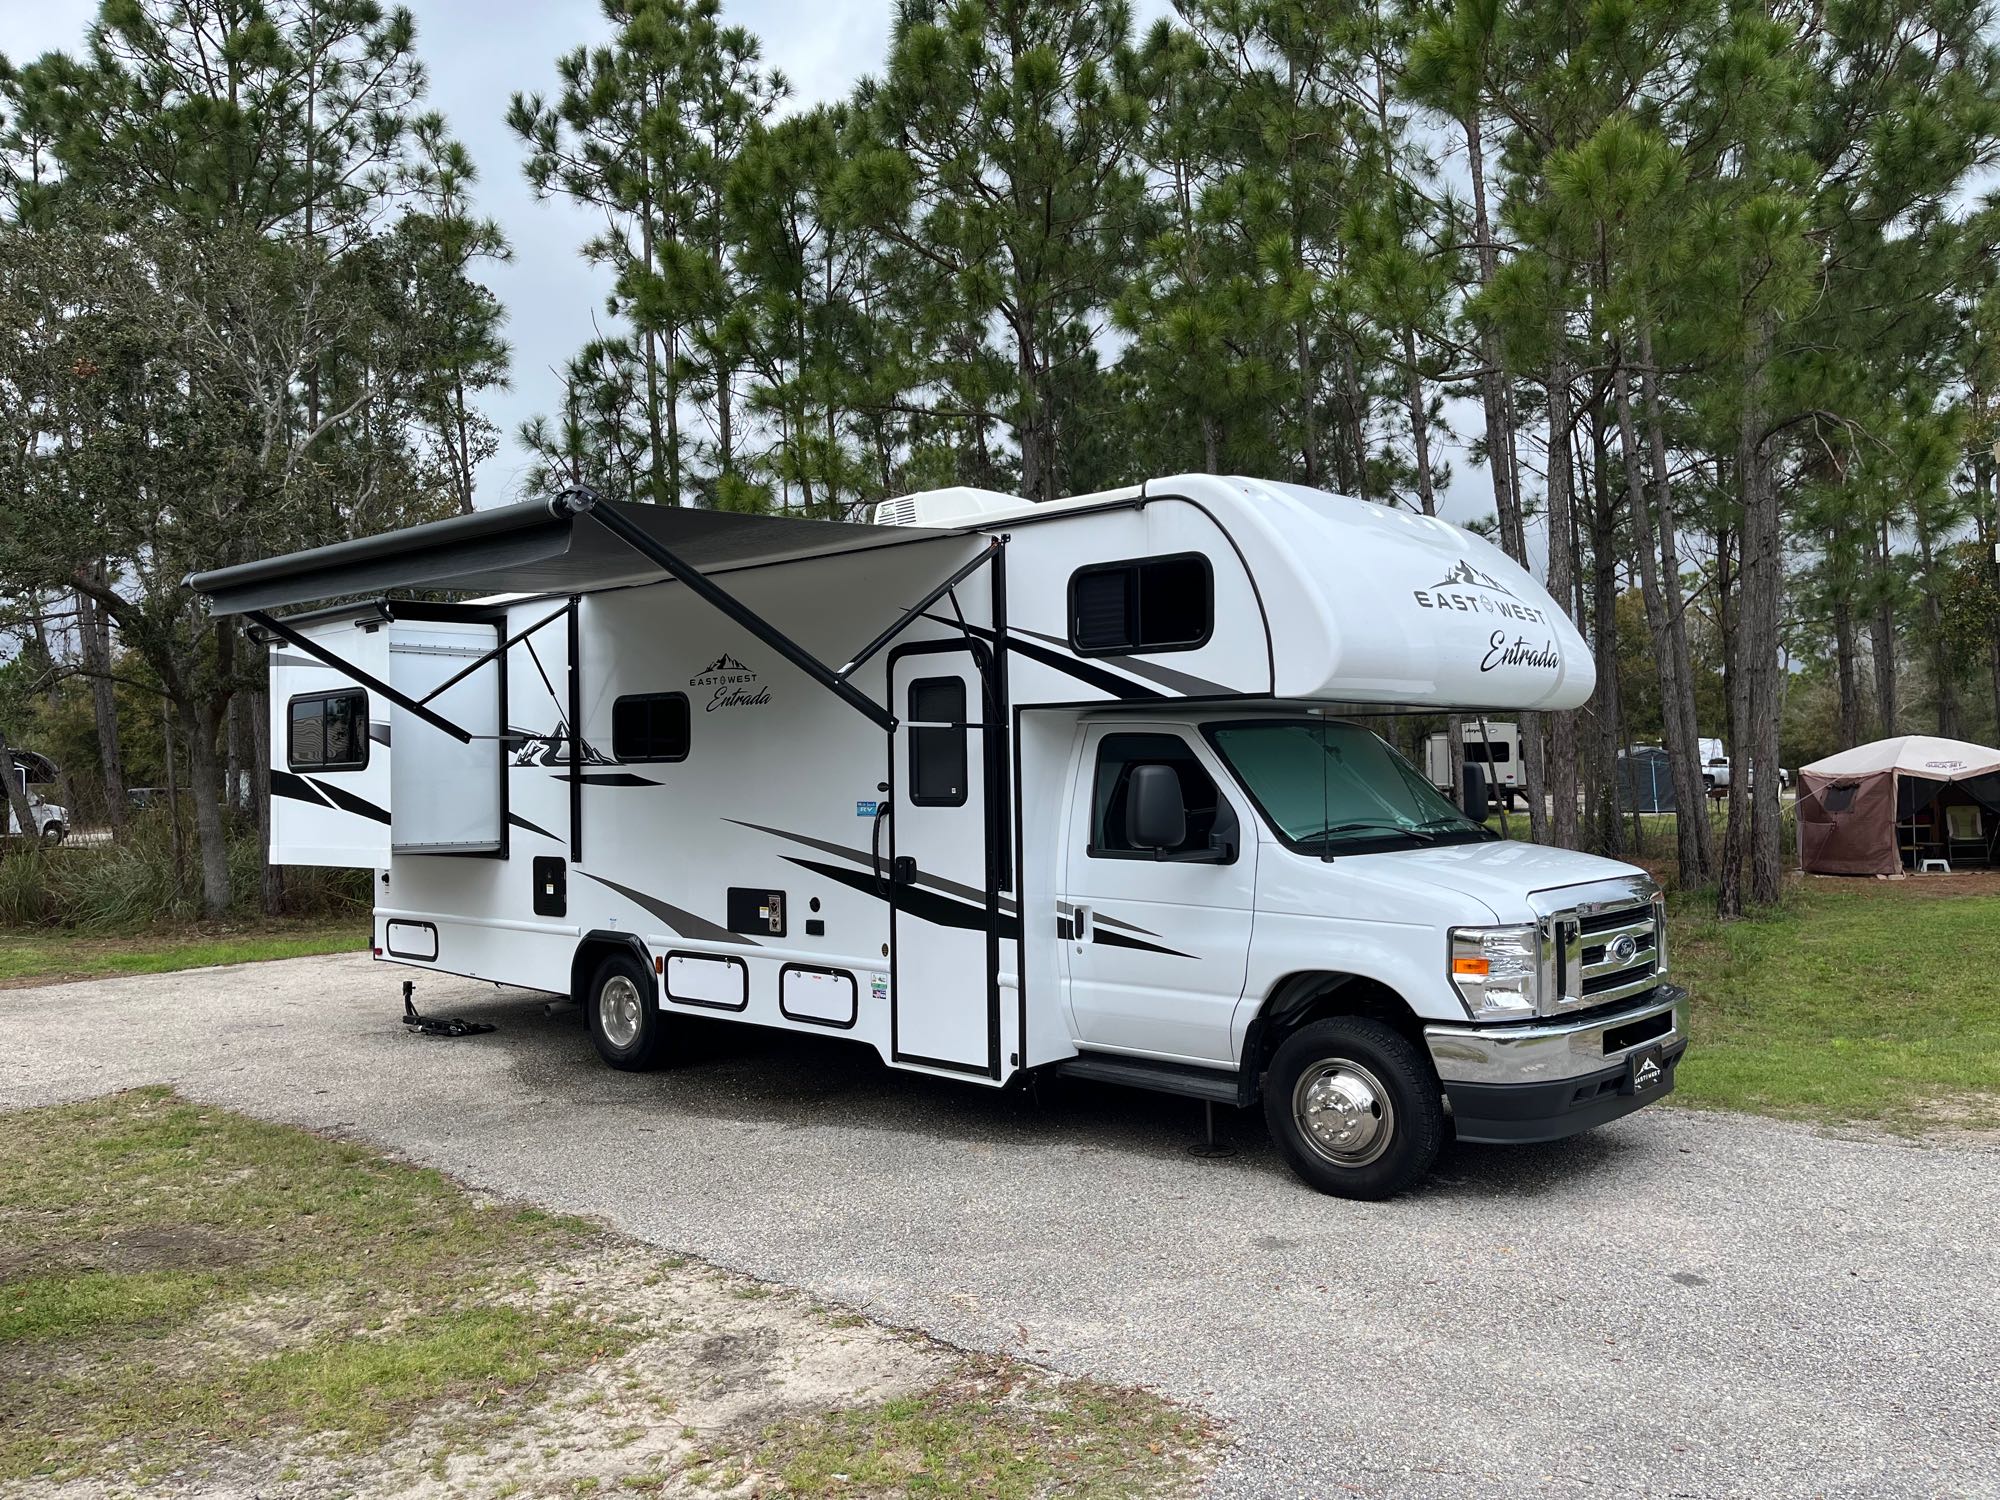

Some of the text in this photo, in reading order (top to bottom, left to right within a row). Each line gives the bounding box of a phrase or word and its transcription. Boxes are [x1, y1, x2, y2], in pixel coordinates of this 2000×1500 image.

[1413, 590, 1546, 625] EAST WEST
[1480, 629, 1560, 673] Entrada
[689, 674, 758, 687] EAST WEST
[706, 685, 772, 713] Entrada
